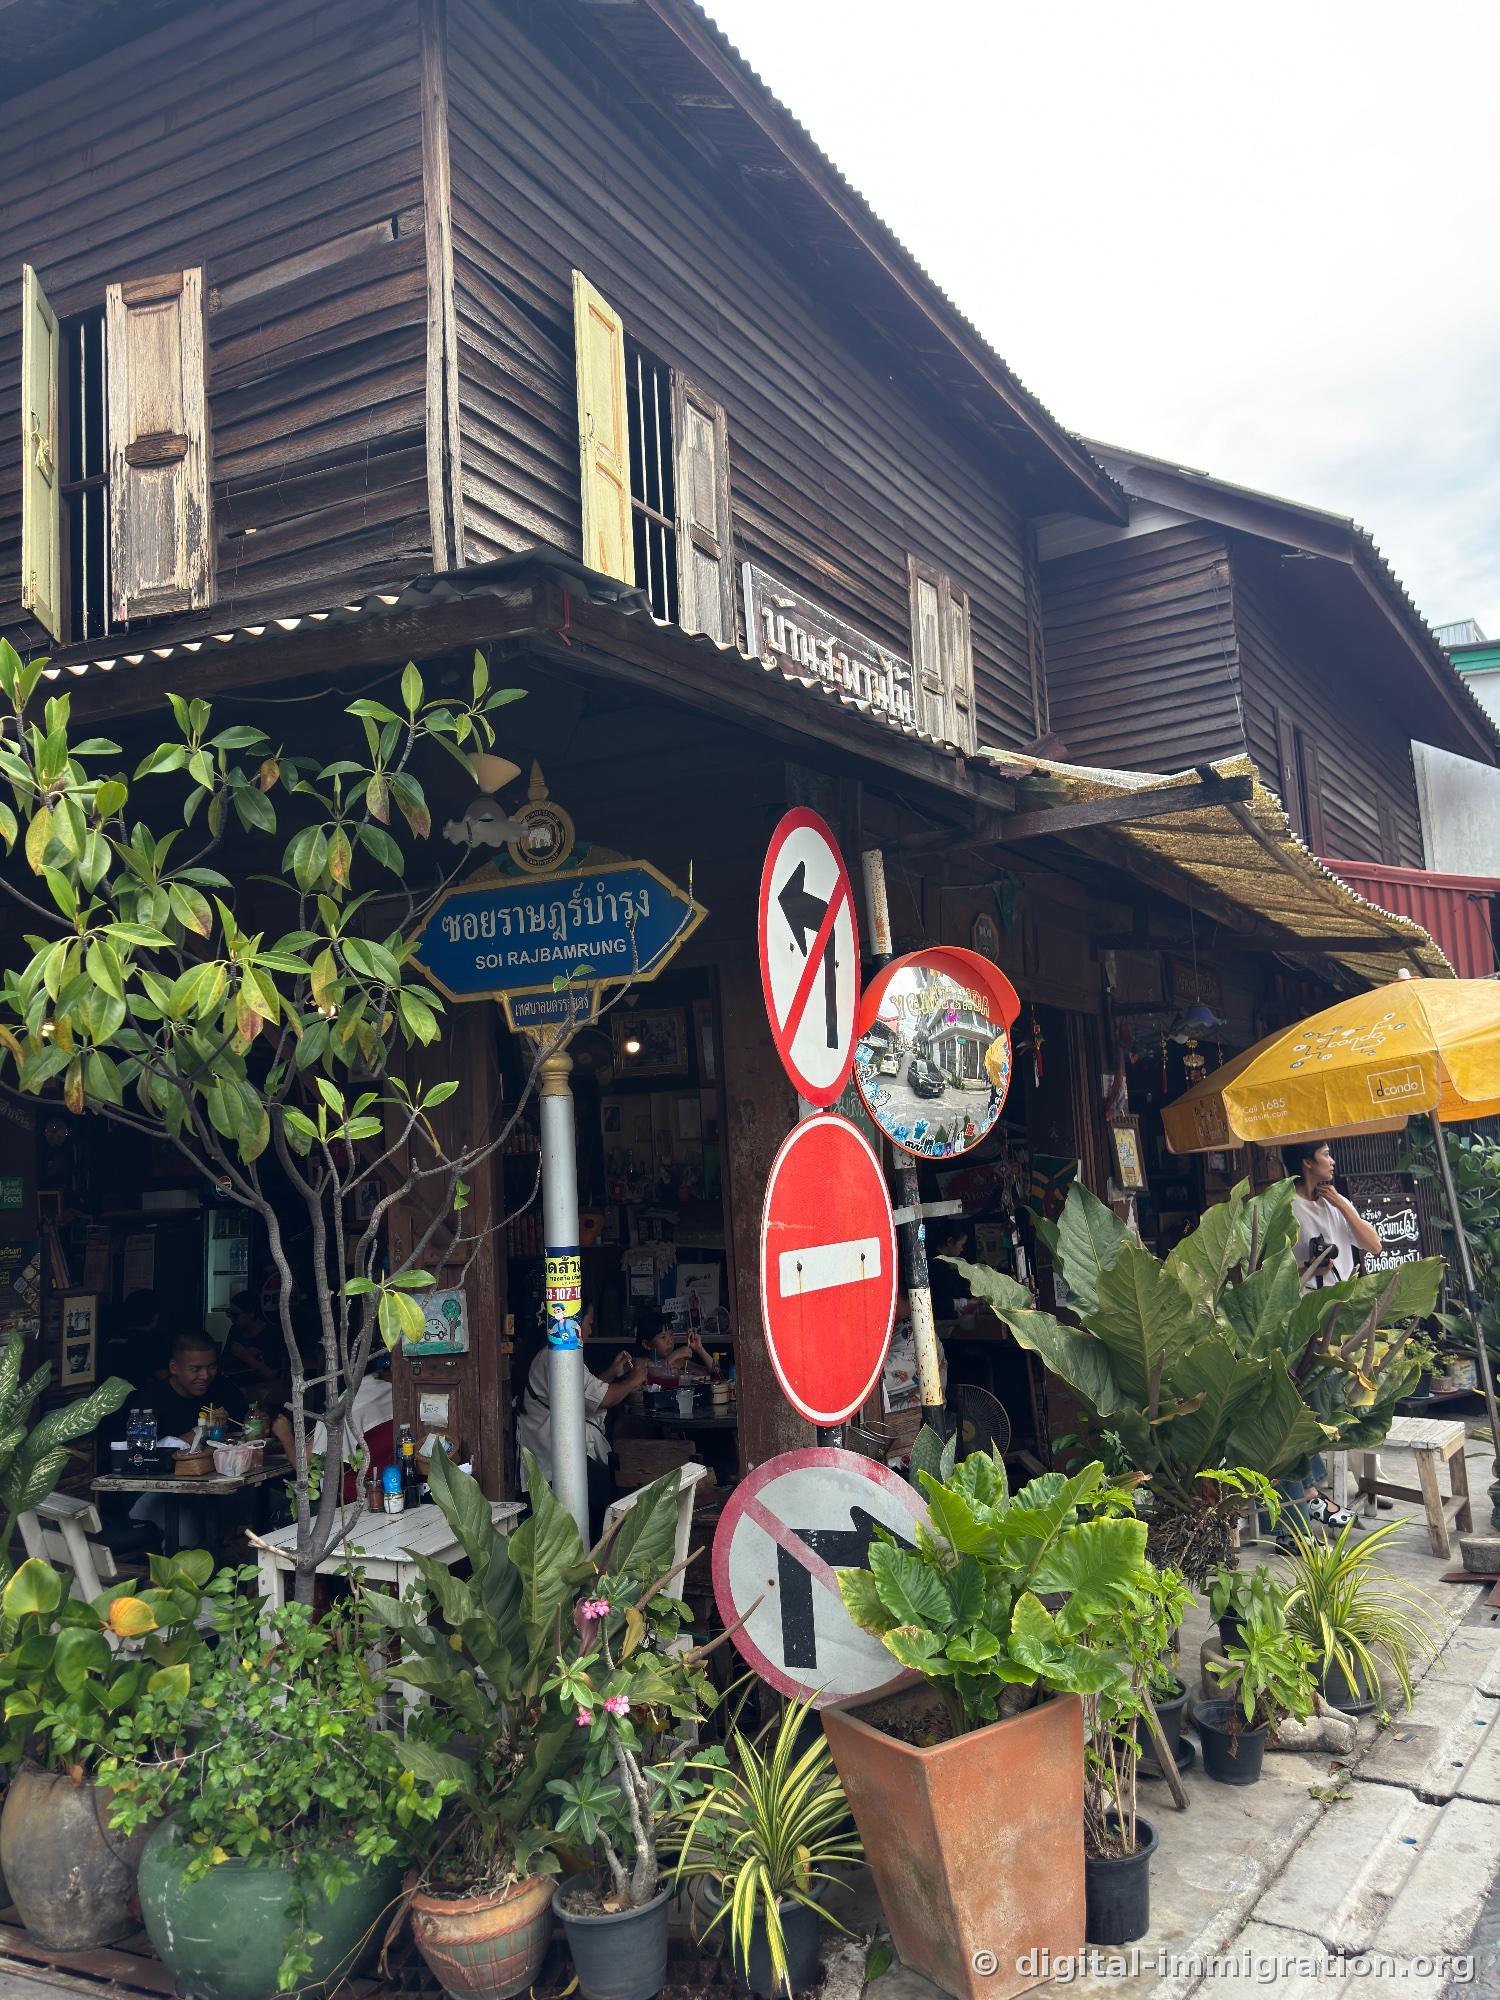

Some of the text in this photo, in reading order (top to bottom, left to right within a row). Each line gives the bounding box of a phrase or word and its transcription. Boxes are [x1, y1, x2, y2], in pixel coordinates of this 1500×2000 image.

[762, 594, 911, 724] บ้านสะพานไม้
[442, 881, 650, 942] ซอยราษฎร์บำรุง
[475, 938, 627, 970] SOI RAJBAMRUNG
[1376, 1072, 1418, 1096] dcondo
[1260, 1098, 1285, 1111] 1685
